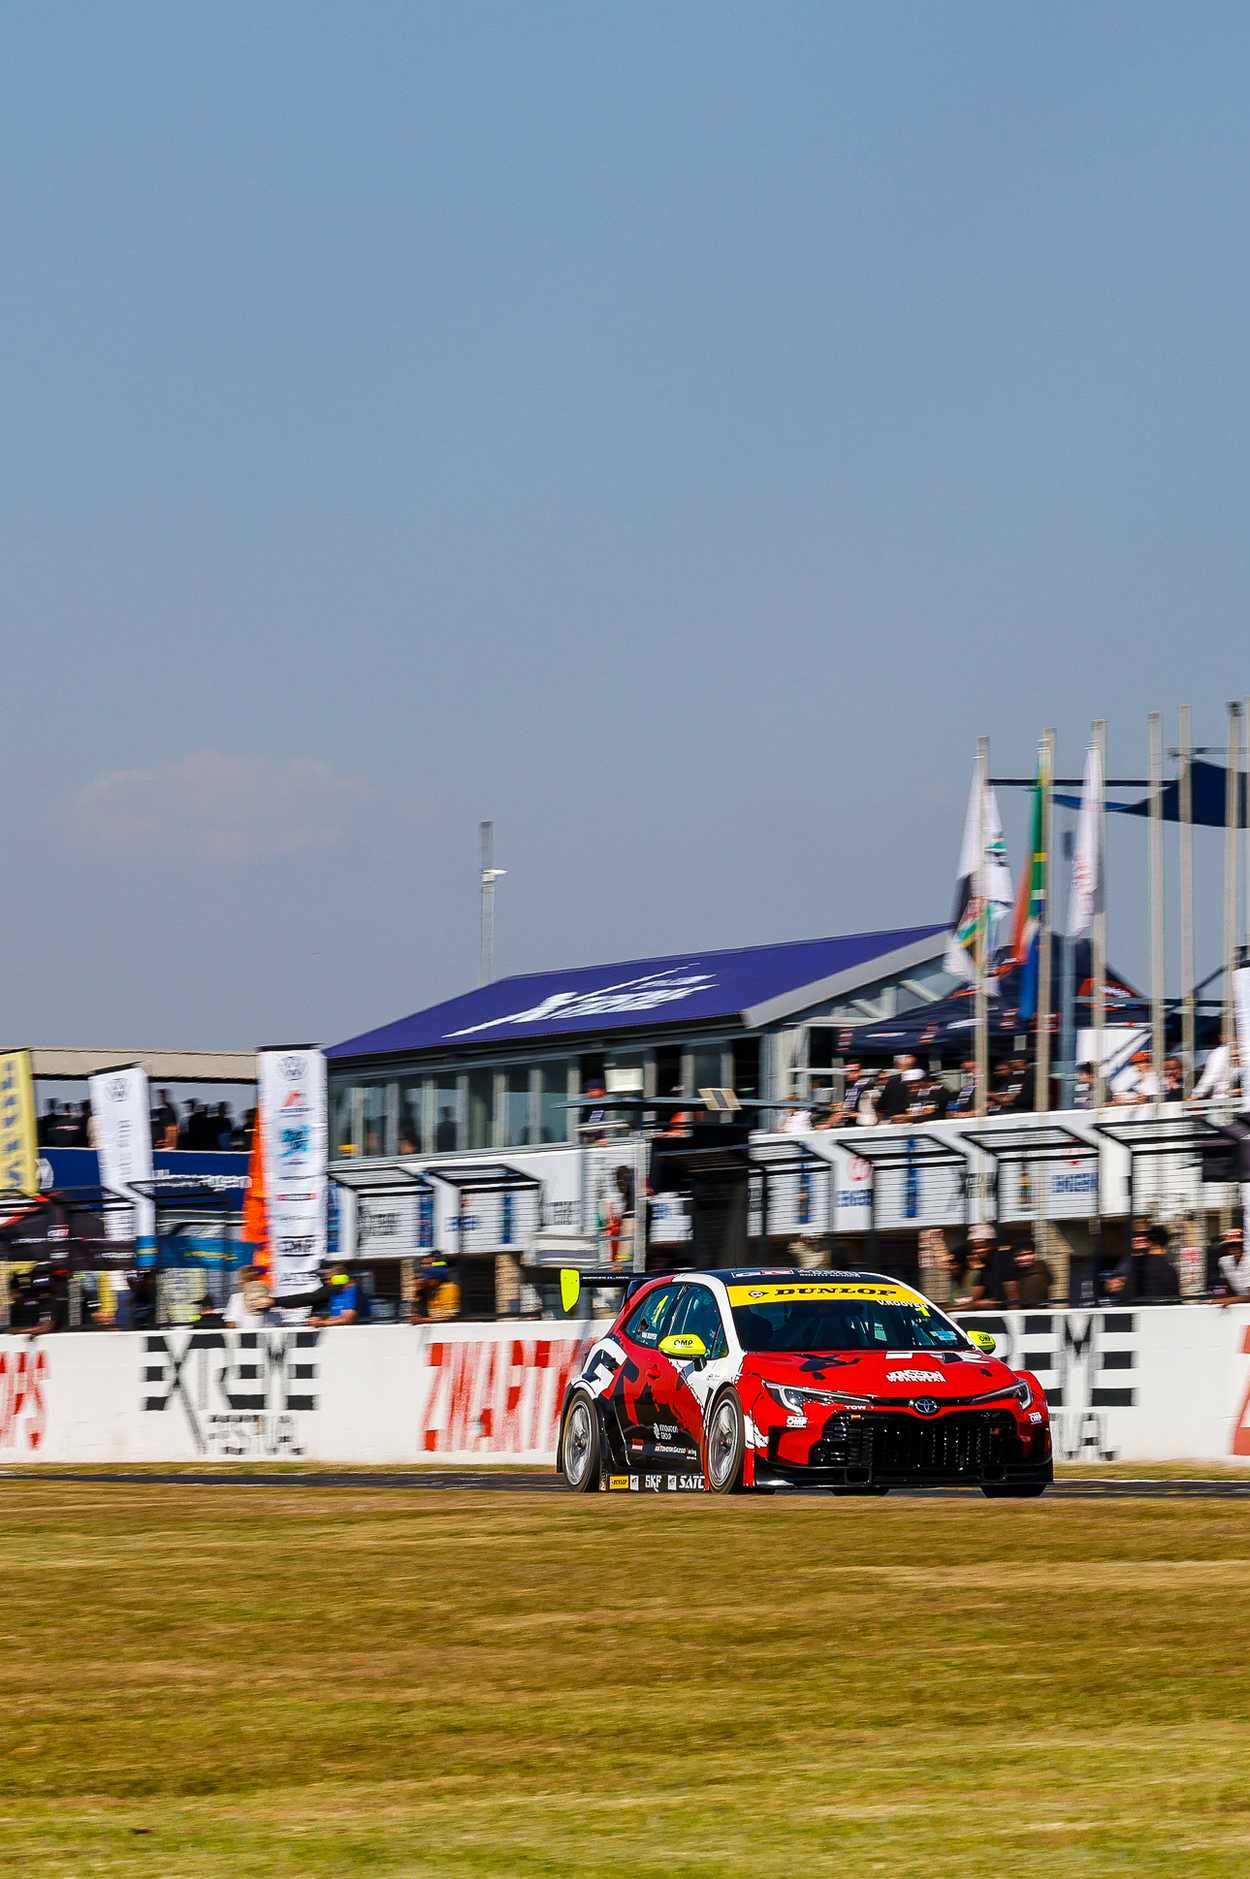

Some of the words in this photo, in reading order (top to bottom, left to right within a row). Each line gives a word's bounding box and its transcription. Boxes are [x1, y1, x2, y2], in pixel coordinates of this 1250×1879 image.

[774, 1287, 897, 1297] DUNLOP
[674, 1339, 693, 1347] OMP
[787, 1416, 809, 1428] OMP
[645, 1474, 662, 1489] SKF
